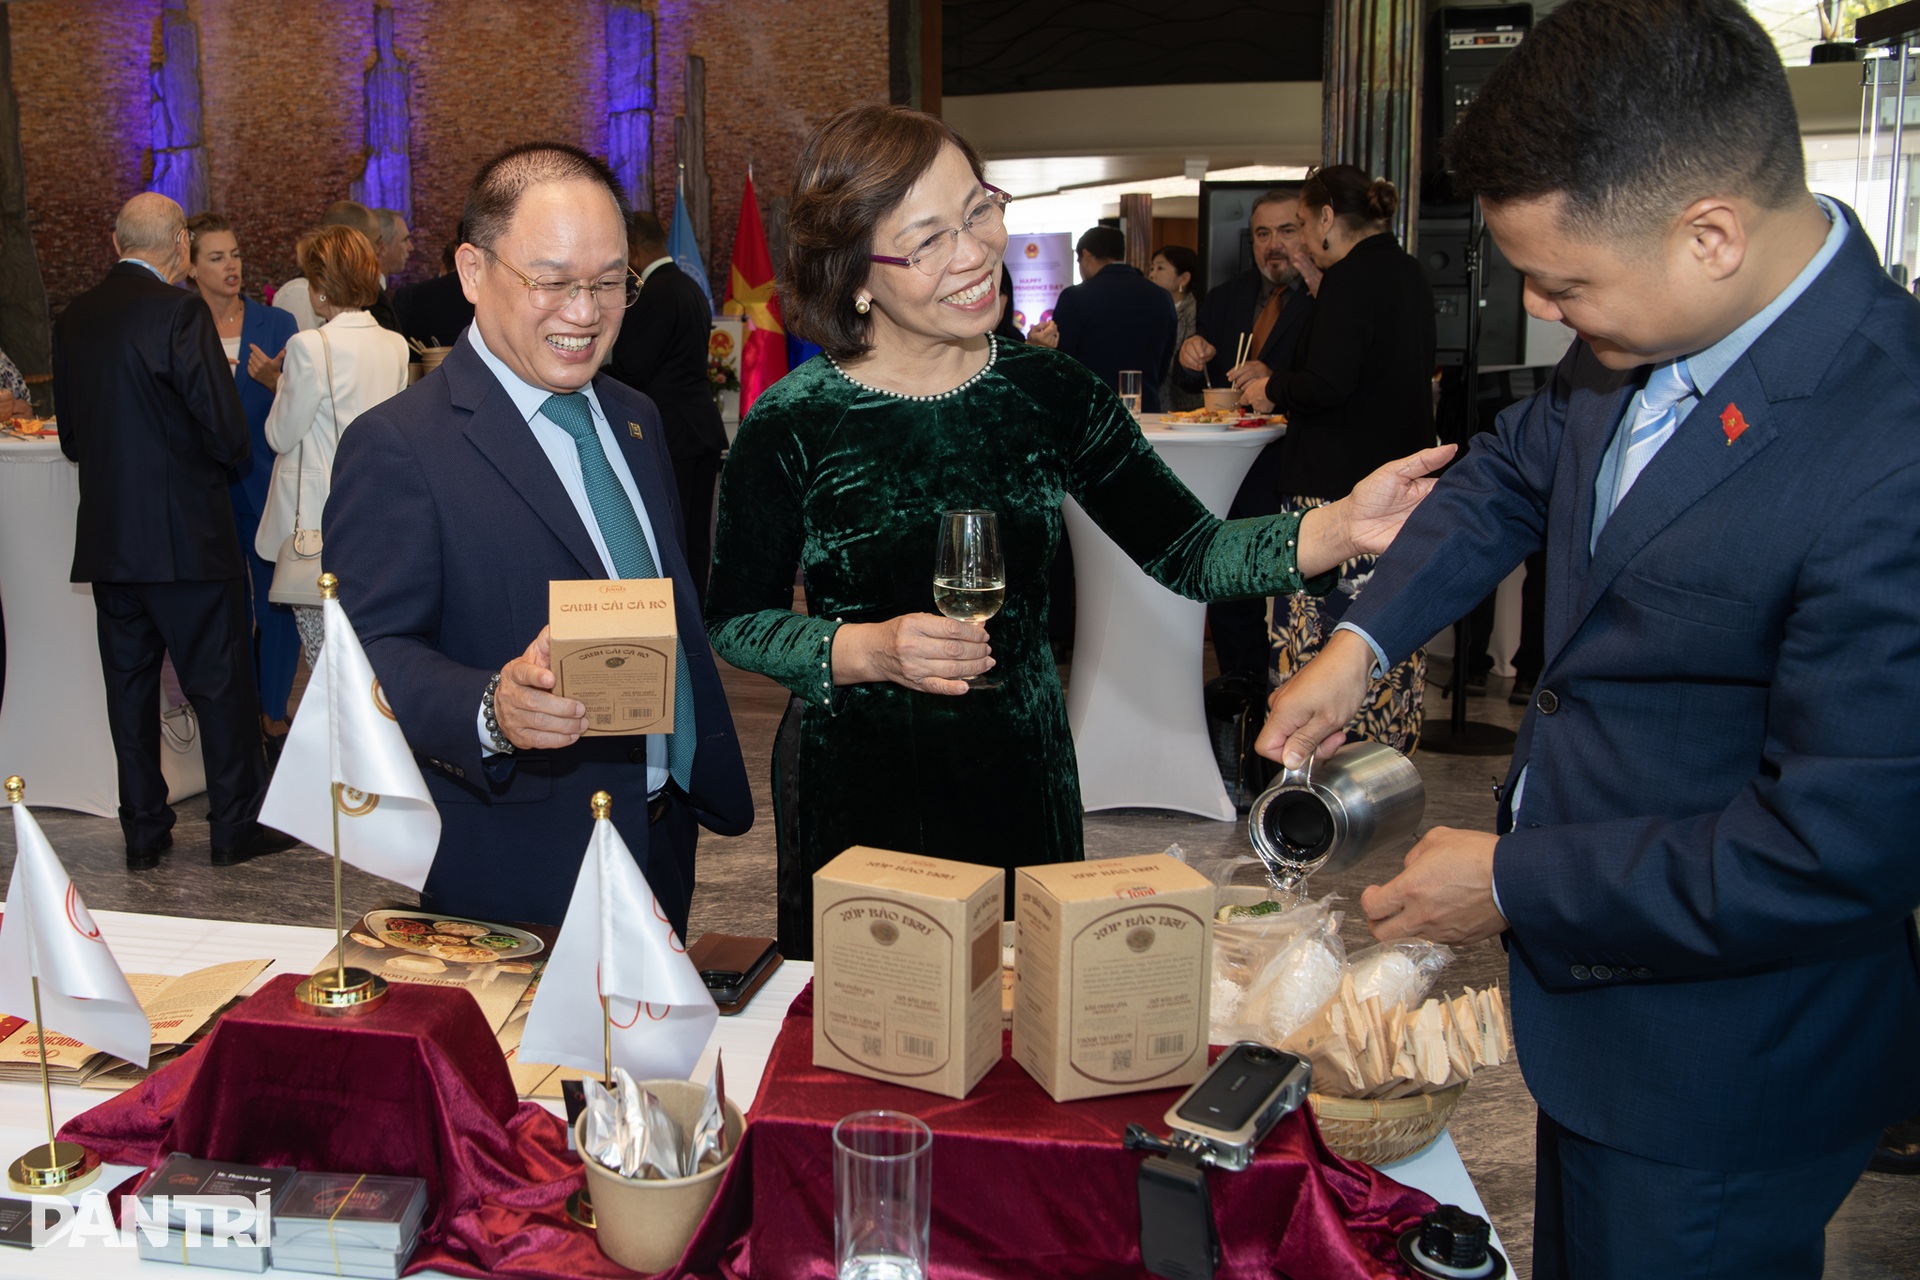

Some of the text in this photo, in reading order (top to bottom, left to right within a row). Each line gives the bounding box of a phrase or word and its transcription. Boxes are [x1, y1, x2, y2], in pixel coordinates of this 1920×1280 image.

[560, 603, 598, 612] CANH
[627, 599, 645, 610] CÁ
[649, 599, 667, 609] RÔ
[579, 649, 603, 661] CANH
[839, 906, 935, 936] XÚP BÀO NGƯ
[1093, 913, 1189, 941] XÚP BÀO NGƯ
[378, 971, 469, 987] Sterilized Food
